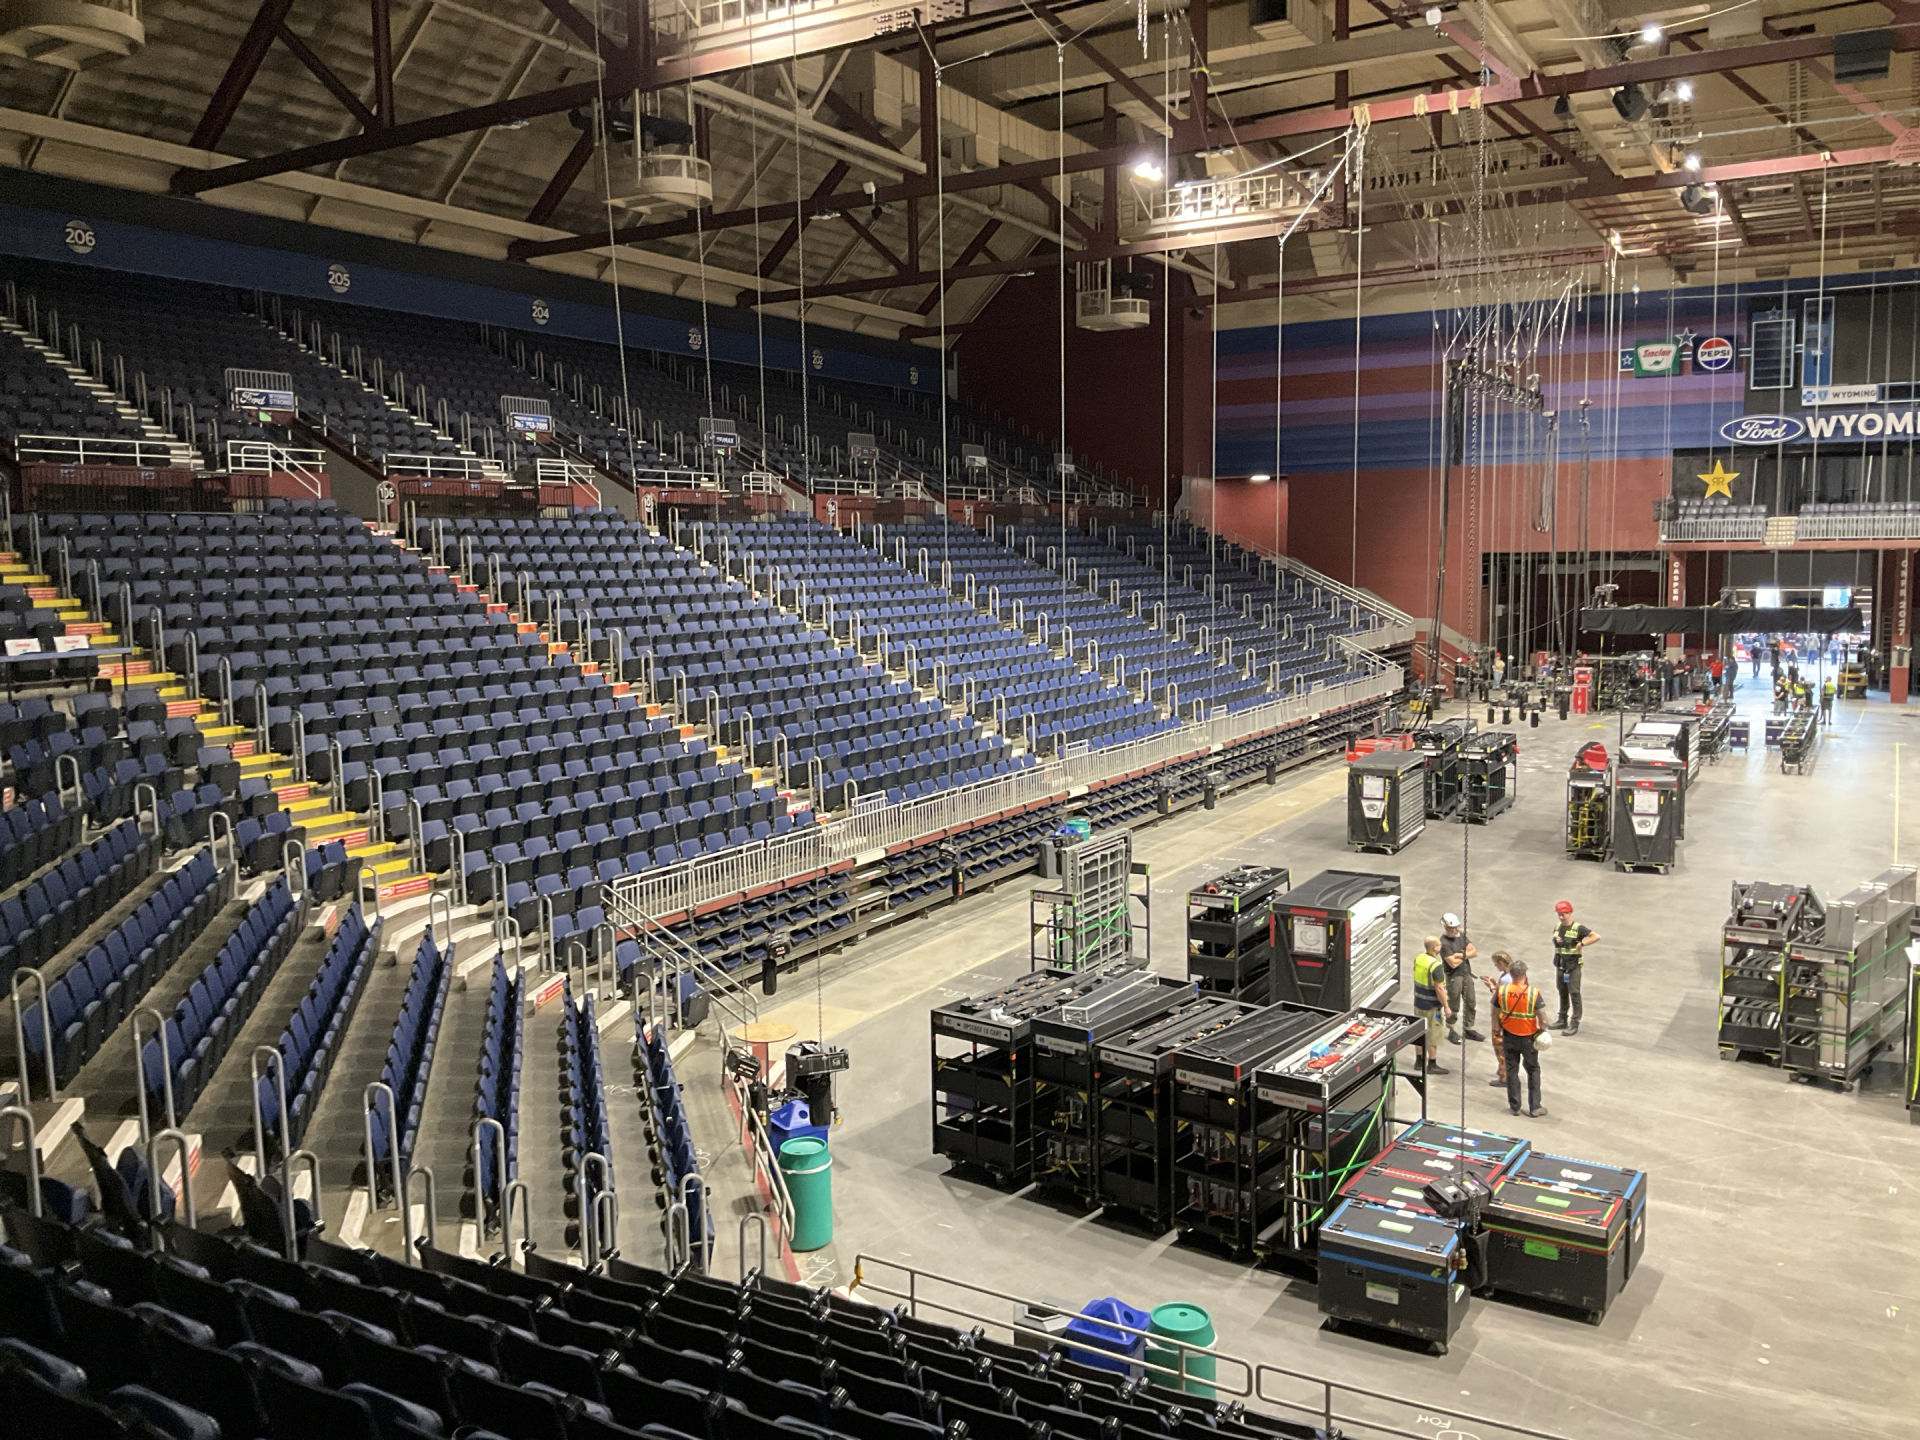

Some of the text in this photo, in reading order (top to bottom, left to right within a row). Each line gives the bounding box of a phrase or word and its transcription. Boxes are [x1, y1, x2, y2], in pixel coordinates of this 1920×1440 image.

[65, 229, 96, 247] 206
[328, 271, 351, 287] 205
[531, 304, 550, 320] 204
[688, 333, 702, 346] 203
[812, 354, 823, 365] 202
[1643, 348, 1672, 358] Sinclair
[1700, 350, 1730, 358] PEPSI
[240, 392, 266, 405] Ford
[1832, 390, 1877, 399] WYOMING
[1736, 420, 1787, 440] Ford
[379, 487, 395, 499] 106
[1672, 561, 1681, 601] CASPER
[1898, 601, 1906, 636] 2027
[1508, 991, 1528, 999] TAT
[963, 1022, 983, 1033] UPSTAGE
[990, 1028, 1003, 1037] CART
[1179, 1072, 1187, 1080] 4B
[1261, 1090, 1269, 1098] 4A
[1416, 1414, 1452, 1429] FOH
